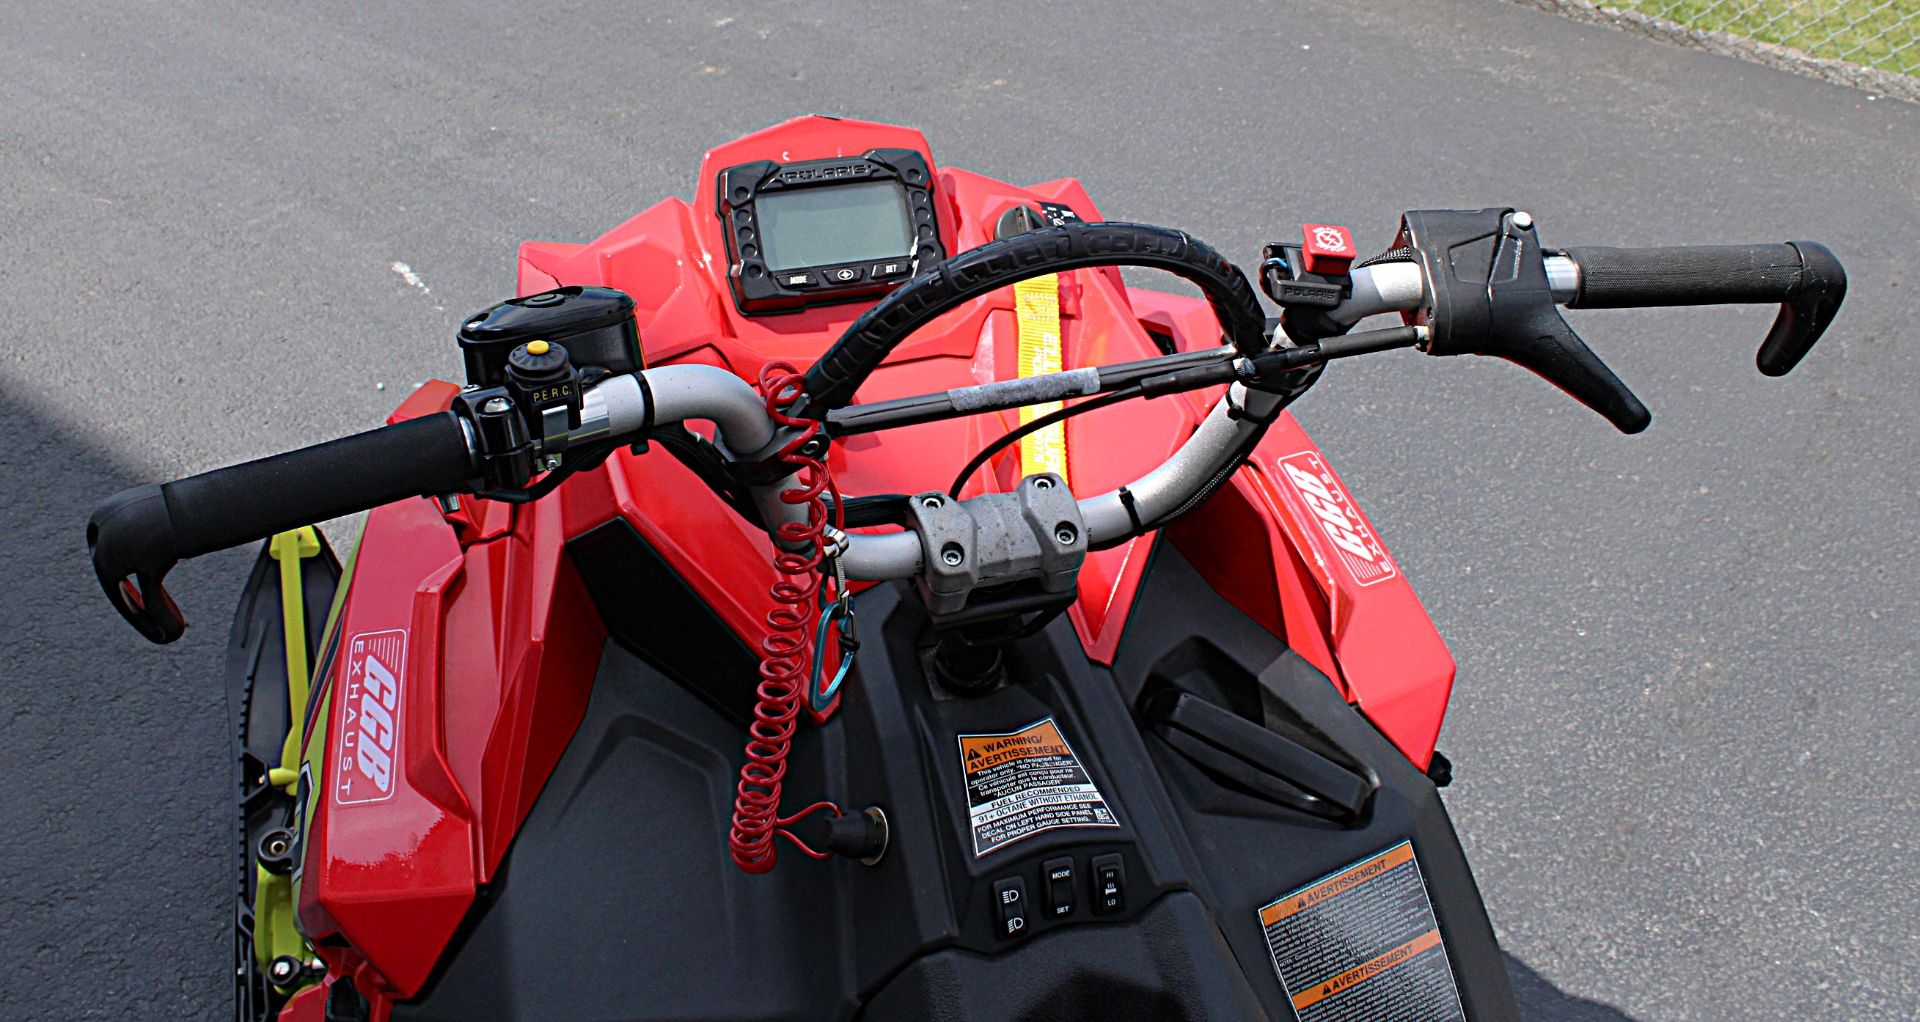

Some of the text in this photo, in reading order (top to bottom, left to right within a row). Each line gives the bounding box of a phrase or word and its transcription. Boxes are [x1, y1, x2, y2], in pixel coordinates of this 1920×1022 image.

[785, 164, 867, 182] POLARIS
[885, 264, 898, 274] SET
[790, 275, 807, 285] MODE
[1284, 288, 1336, 300] POLARIS
[1307, 457, 1392, 573] EXHAUST
[340, 640, 364, 796] EXHAUST
[970, 744, 1065, 771] AVERTISSEMENT
[977, 768, 992, 776] This
[993, 761, 1016, 772] vehicle
[1023, 756, 1052, 765] designed
[970, 773, 998, 786] operator
[980, 781, 1017, 797] transporter
[991, 786, 1081, 809] FUEL RECOMMENDED
[996, 801, 1028, 816] OCTANE
[1028, 795, 1063, 807] WITHOUT
[1065, 793, 1099, 802] ETHANOL
[977, 825, 993, 833] FOR
[993, 814, 1028, 829] MAXIMUM
[1028, 804, 1078, 816] PERFORMANCE
[981, 828, 1004, 839] DECAL
[1017, 818, 1034, 828] LEFT
[1035, 813, 1055, 822] HAND
[991, 835, 1007, 843] FOR
[1007, 824, 1036, 839] PROPER
[1036, 818, 1062, 828] GAUGE
[1052, 870, 1070, 880] MODE
[1306, 859, 1388, 904] AVERTISSEMENT
[1056, 905, 1070, 914] SET
[1107, 898, 1116, 906] LO
[1331, 944, 1414, 990] AVERTISSEMENT
